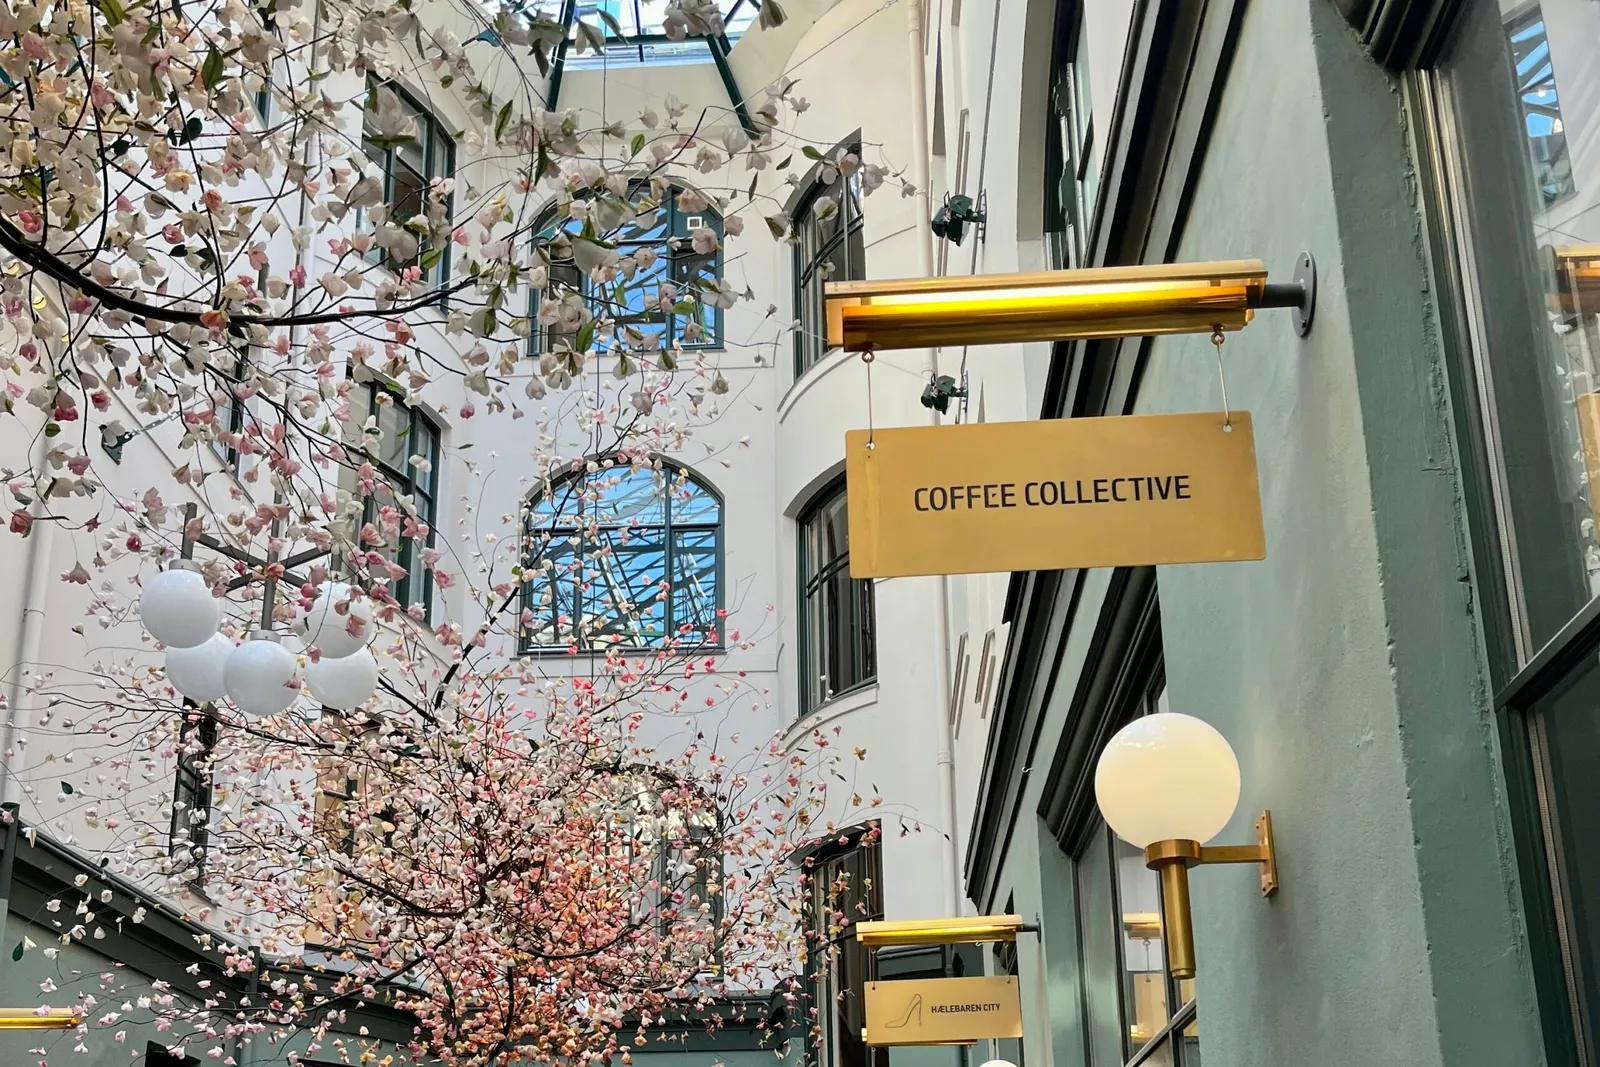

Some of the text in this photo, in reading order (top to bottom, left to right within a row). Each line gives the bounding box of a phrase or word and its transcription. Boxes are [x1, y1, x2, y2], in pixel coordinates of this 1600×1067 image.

[914, 475, 1192, 512] COFFEE COLLECTIVE
[931, 1003, 1001, 1013] HÆLEBAREN CITY
